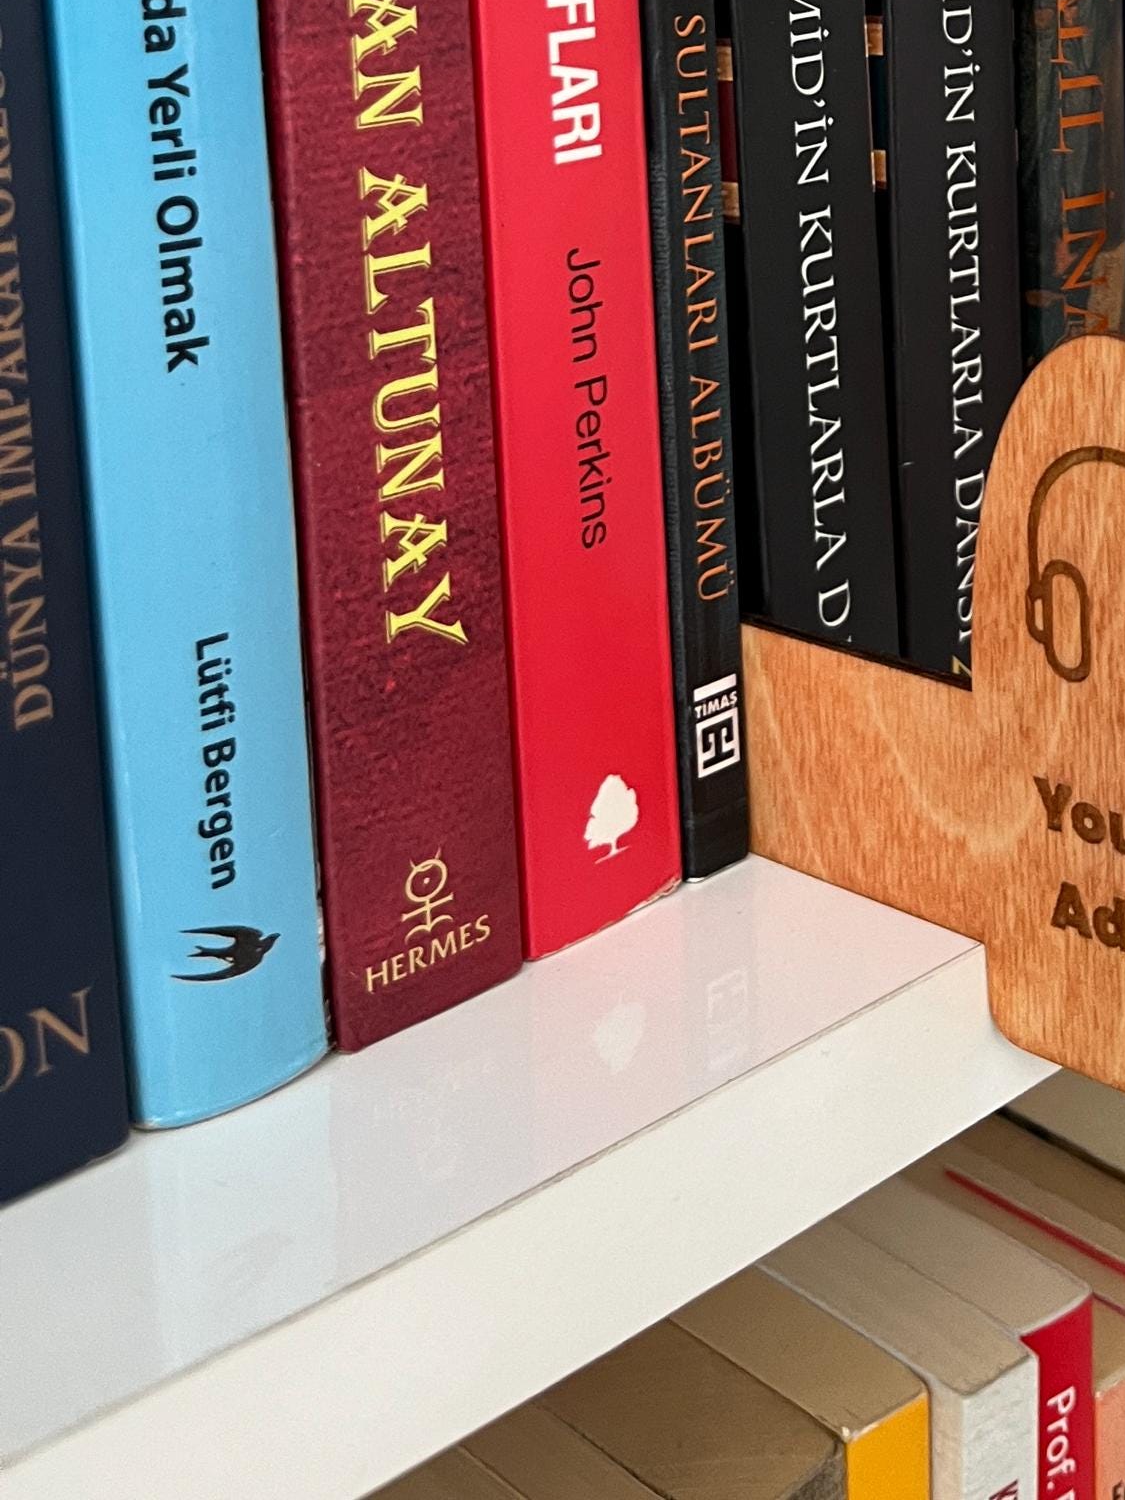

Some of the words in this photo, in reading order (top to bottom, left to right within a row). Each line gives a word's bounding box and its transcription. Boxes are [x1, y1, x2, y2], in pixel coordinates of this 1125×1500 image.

[145, 60, 198, 182] Yerli
[672, 14, 718, 357] SULTANLARI
[154, 193, 210, 374] Olmak
[566, 247, 602, 365] John
[945, 141, 985, 460] KURTLARLA
[357, 165, 470, 647] ALTUNAY
[574, 375, 611, 552] Perkins
[798, 205, 848, 571] KURTLARLA
[689, 373, 734, 604] ALBÜMÜ
[0, 510, 55, 733] DÜNYA
[194, 631, 236, 733] Lütfi
[196, 737, 238, 892] Bergen
[365, 912, 494, 996] HERMES
[1046, 1385, 1077, 1491] Prof.
